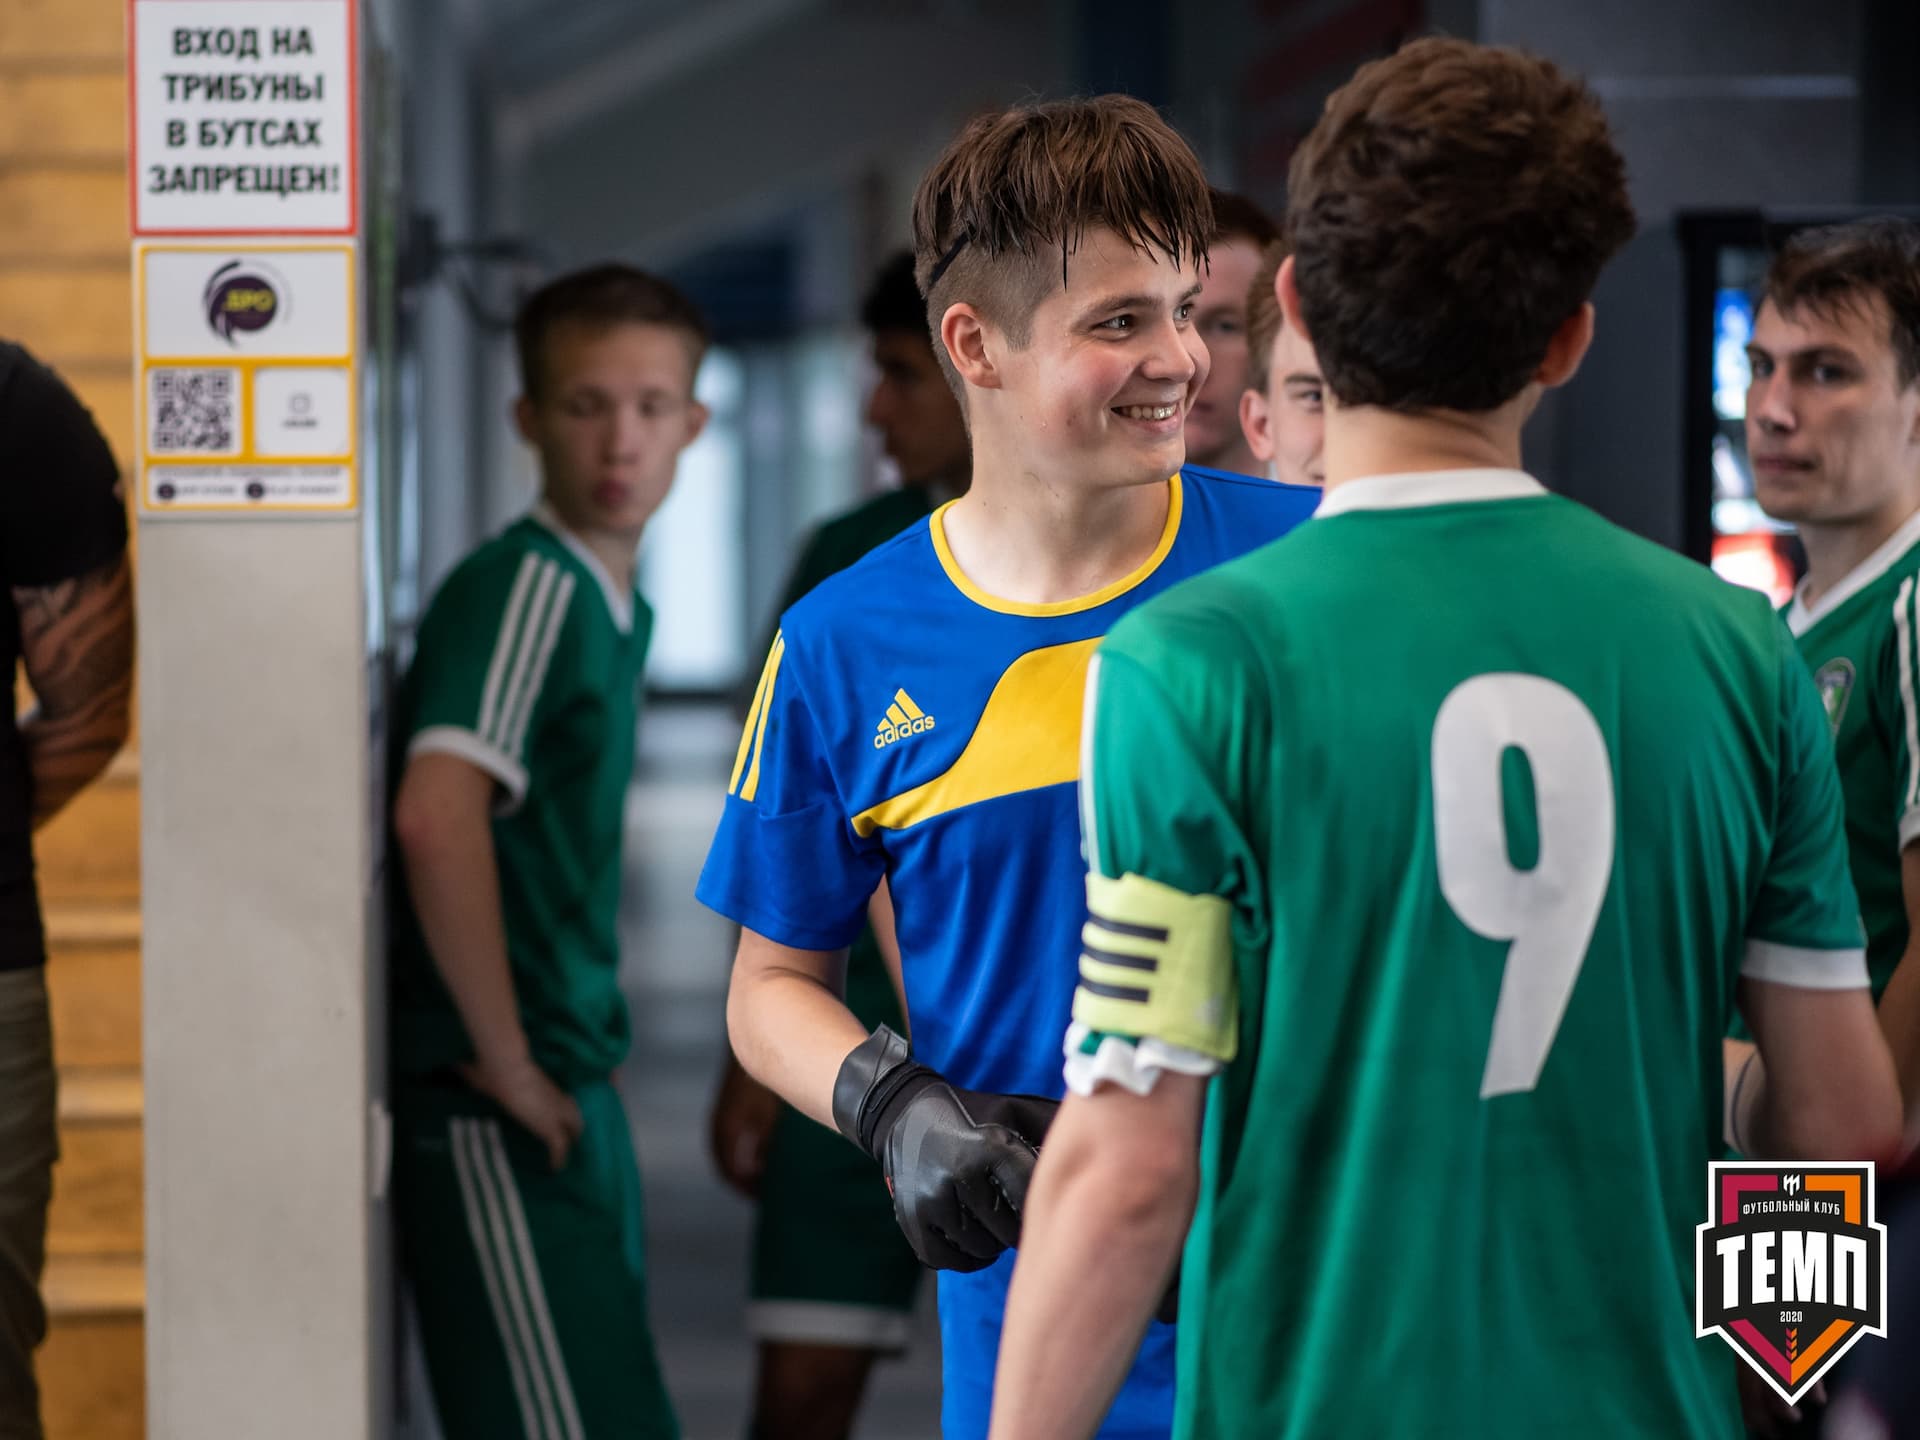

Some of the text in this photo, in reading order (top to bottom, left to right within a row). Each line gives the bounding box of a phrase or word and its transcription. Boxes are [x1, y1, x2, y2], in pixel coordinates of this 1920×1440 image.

[172, 27, 315, 60] ВХОД НА
[162, 73, 325, 102] ТРИБУНЫ
[166, 118, 322, 148] В БУТСАХ
[147, 163, 341, 199] ЗАПРЕЩЕН!
[874, 715, 936, 750] adidas
[1430, 671, 1616, 1100] 9
